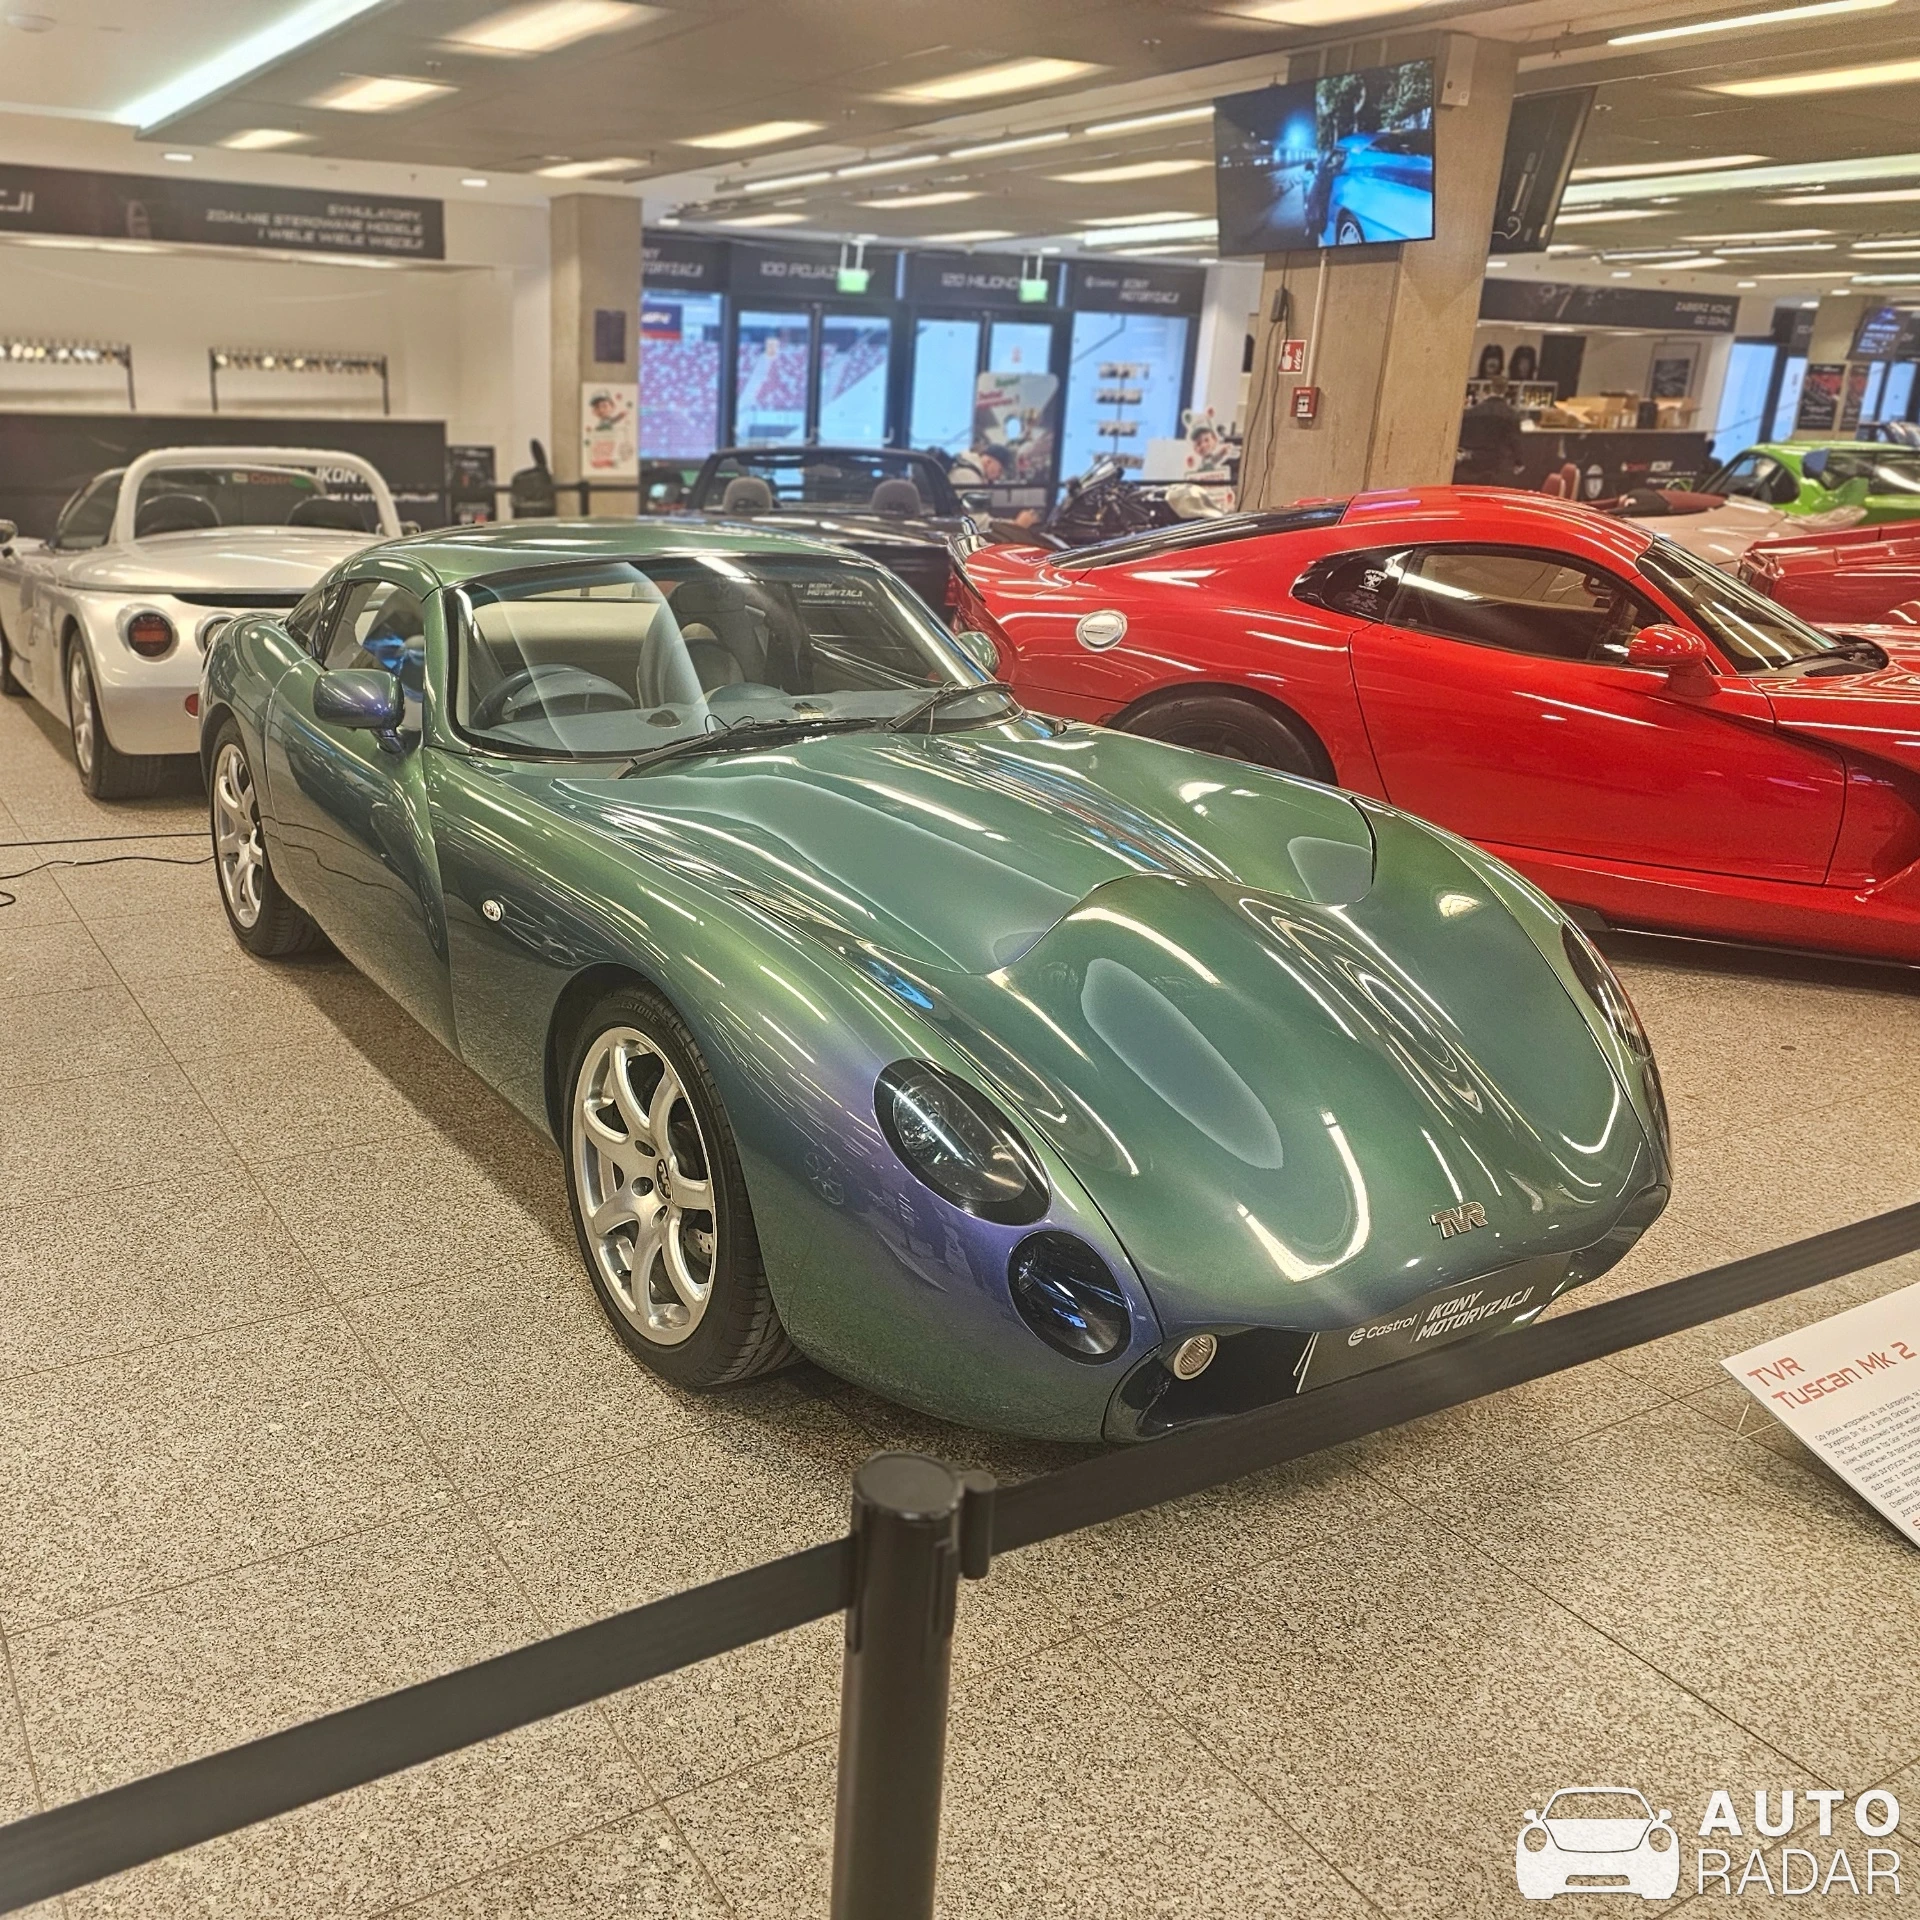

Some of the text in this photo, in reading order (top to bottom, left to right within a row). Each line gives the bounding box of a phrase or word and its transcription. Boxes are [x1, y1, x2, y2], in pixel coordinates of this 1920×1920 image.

[1431, 1201, 1489, 1239] TVR
[1366, 1290, 1483, 1340] Castrol IKONY
[1415, 1286, 1535, 1343] MOTORYZACJI
[1746, 1356, 1806, 1387] TVR
[1770, 1341, 1918, 1409] Tuscan Mk 2
